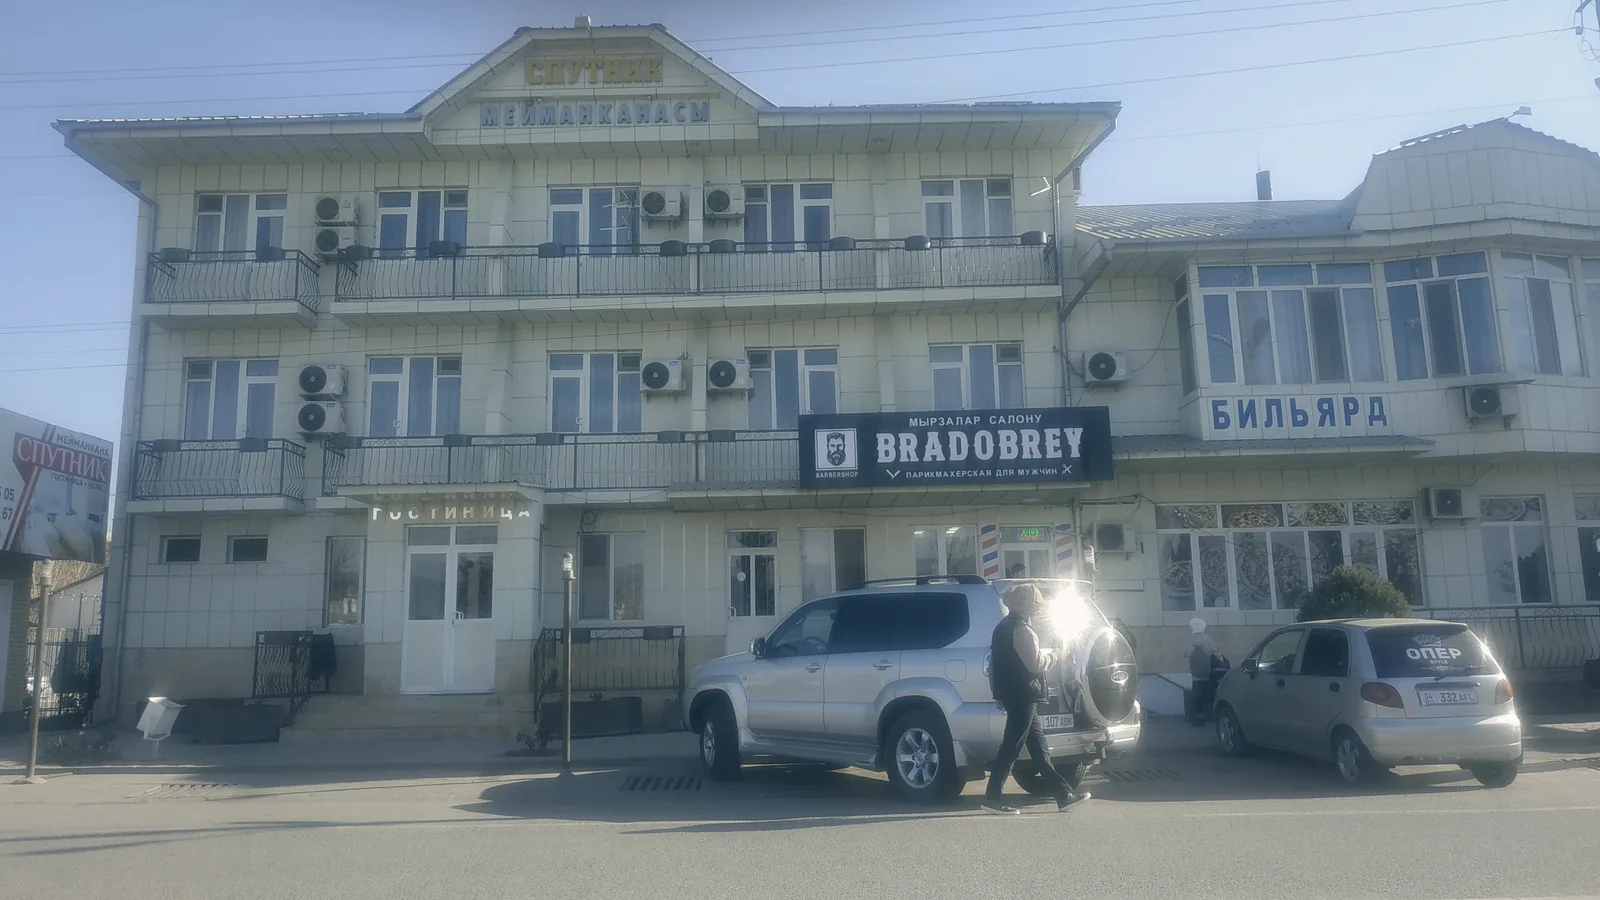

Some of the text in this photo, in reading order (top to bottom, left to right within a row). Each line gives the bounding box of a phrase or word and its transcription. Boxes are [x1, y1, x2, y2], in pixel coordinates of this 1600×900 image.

[525, 56, 662, 86] СПУТНИК
[481, 101, 709, 127] МЕЙМАНКАНАСЫ
[1211, 396, 1388, 430] БИЛЬЯРД
[908, 414, 1042, 428] МЫРЗАЛАР САЛОНУ
[56, 433, 109, 457] МЕЙМАНКАНА
[875, 427, 1084, 463] BRADOBREY
[17, 436, 108, 482] СПУТНИК
[815, 471, 859, 479] BARBERSHOP
[905, 467, 1058, 479] ПАРИКМАХЕРСКАЯ ДЛЯ МУЖЧИН
[4, 487, 15, 501] 05
[2, 506, 13, 520] 67
[372, 505, 530, 521] ГОСТИНИЦА
[1405, 647, 1462, 660] ОПЕР
[1440, 692, 1458, 703] 332
[1045, 716, 1059, 728] 107
